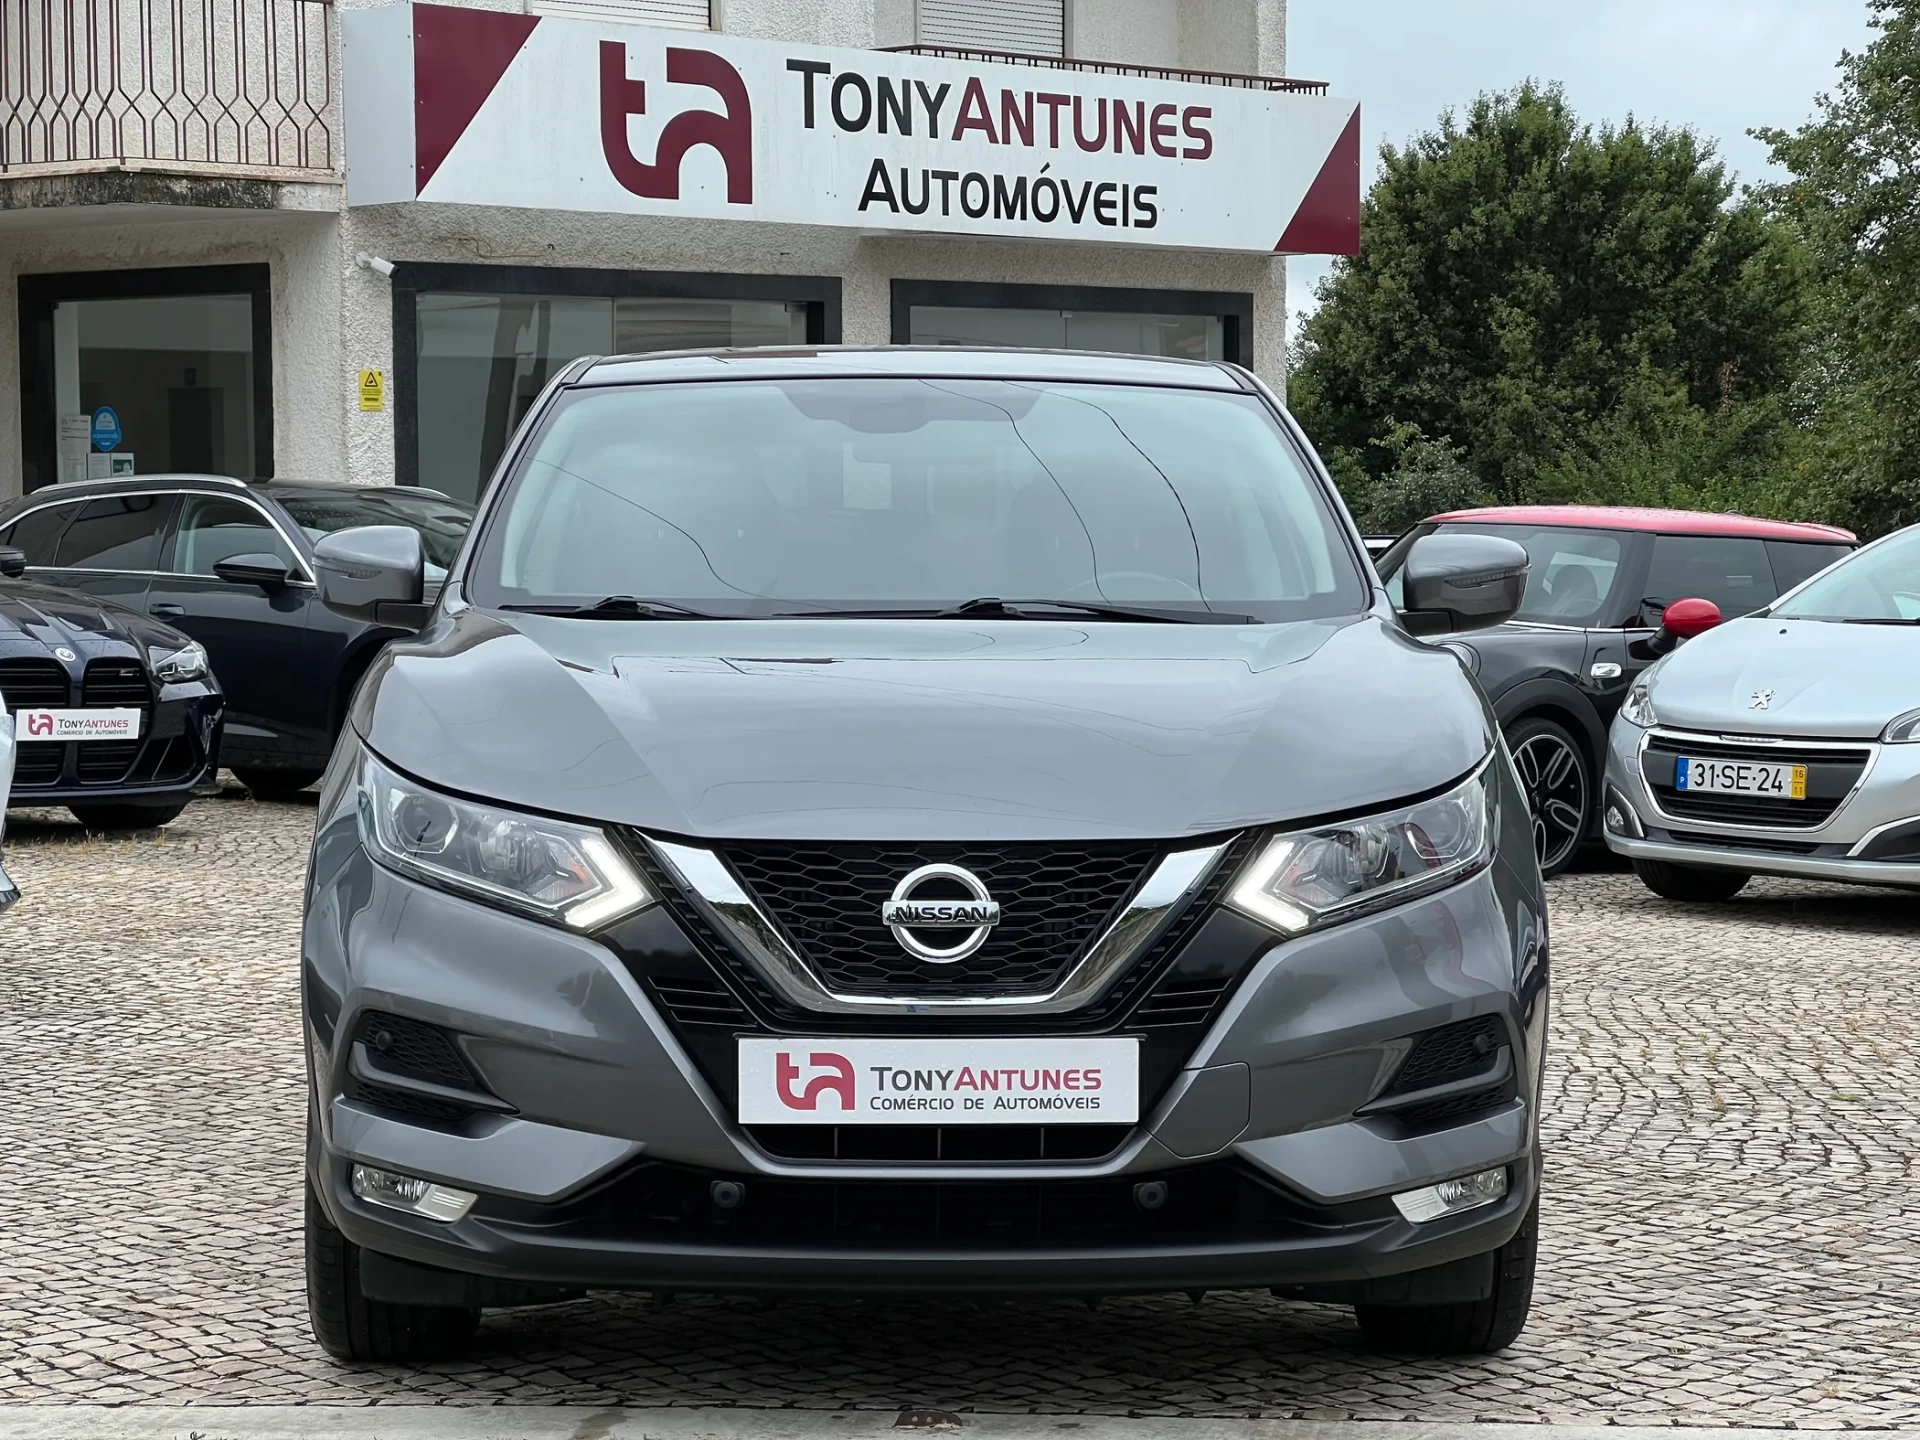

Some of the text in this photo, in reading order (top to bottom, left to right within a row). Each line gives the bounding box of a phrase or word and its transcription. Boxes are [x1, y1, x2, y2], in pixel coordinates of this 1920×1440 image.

[786, 58, 1213, 161] TONYANTUNES
[858, 157, 1158, 229] AUTOMÓVEIS
[58, 718, 129, 729] TONYANTUNES
[1795, 769, 1804, 779] 16
[1794, 786, 1803, 795] 11
[894, 906, 988, 922] NISSAN
[869, 1066, 1101, 1092] TONYANTUNES
[869, 1093, 1101, 1111] COMÉRCIO DE AUTOMÓVEIS
